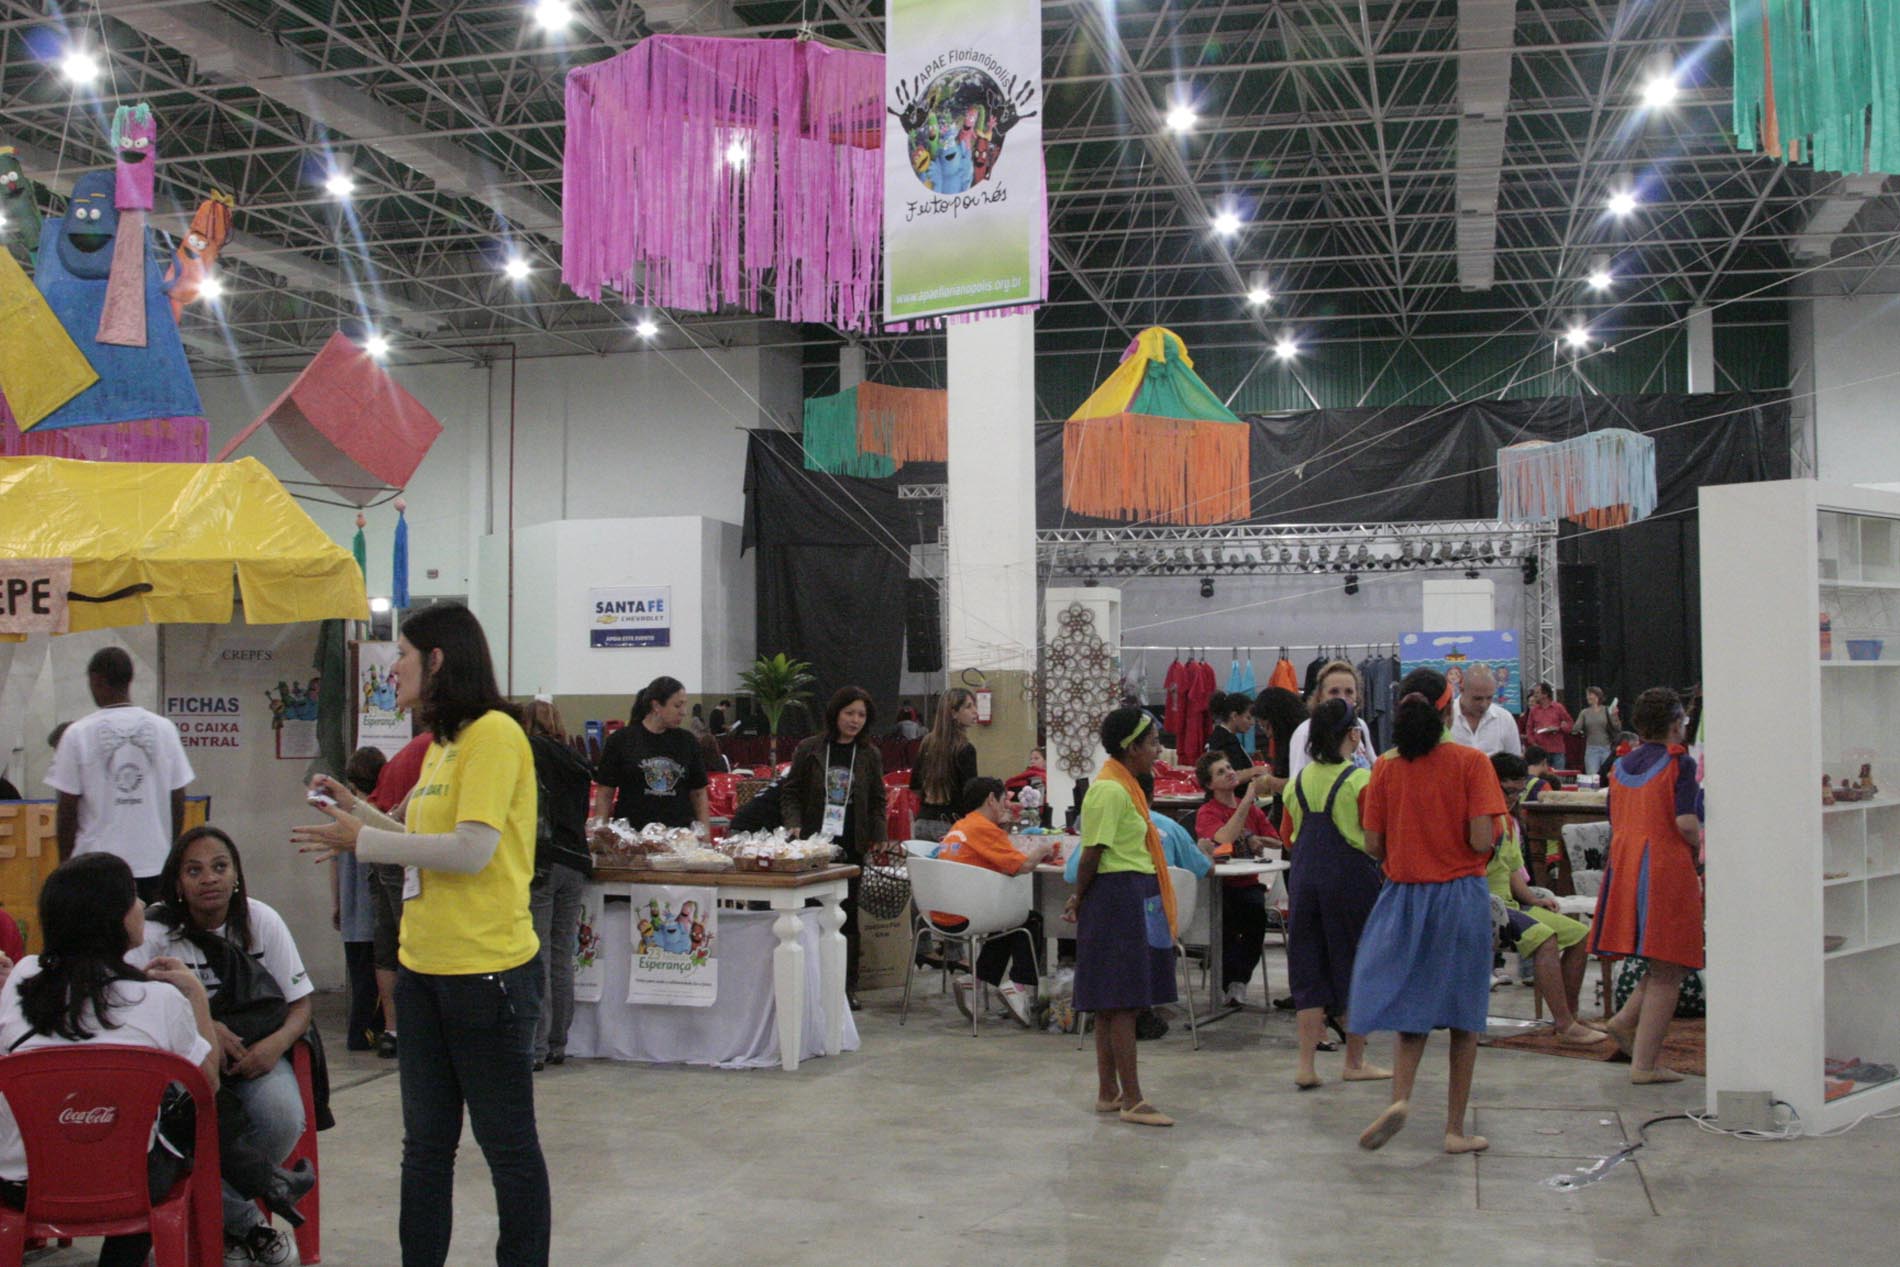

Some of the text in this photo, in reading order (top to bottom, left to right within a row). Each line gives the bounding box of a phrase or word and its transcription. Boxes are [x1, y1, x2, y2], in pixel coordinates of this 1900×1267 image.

[920, 48, 1012, 88] APAE Florianópolis
[595, 601, 645, 613] SANTA
[167, 697, 240, 713] FICHAS
[176, 722, 240, 733] O CAIXA
[180, 736, 240, 747] ENTRAL
[639, 957, 692, 973] Esperança
